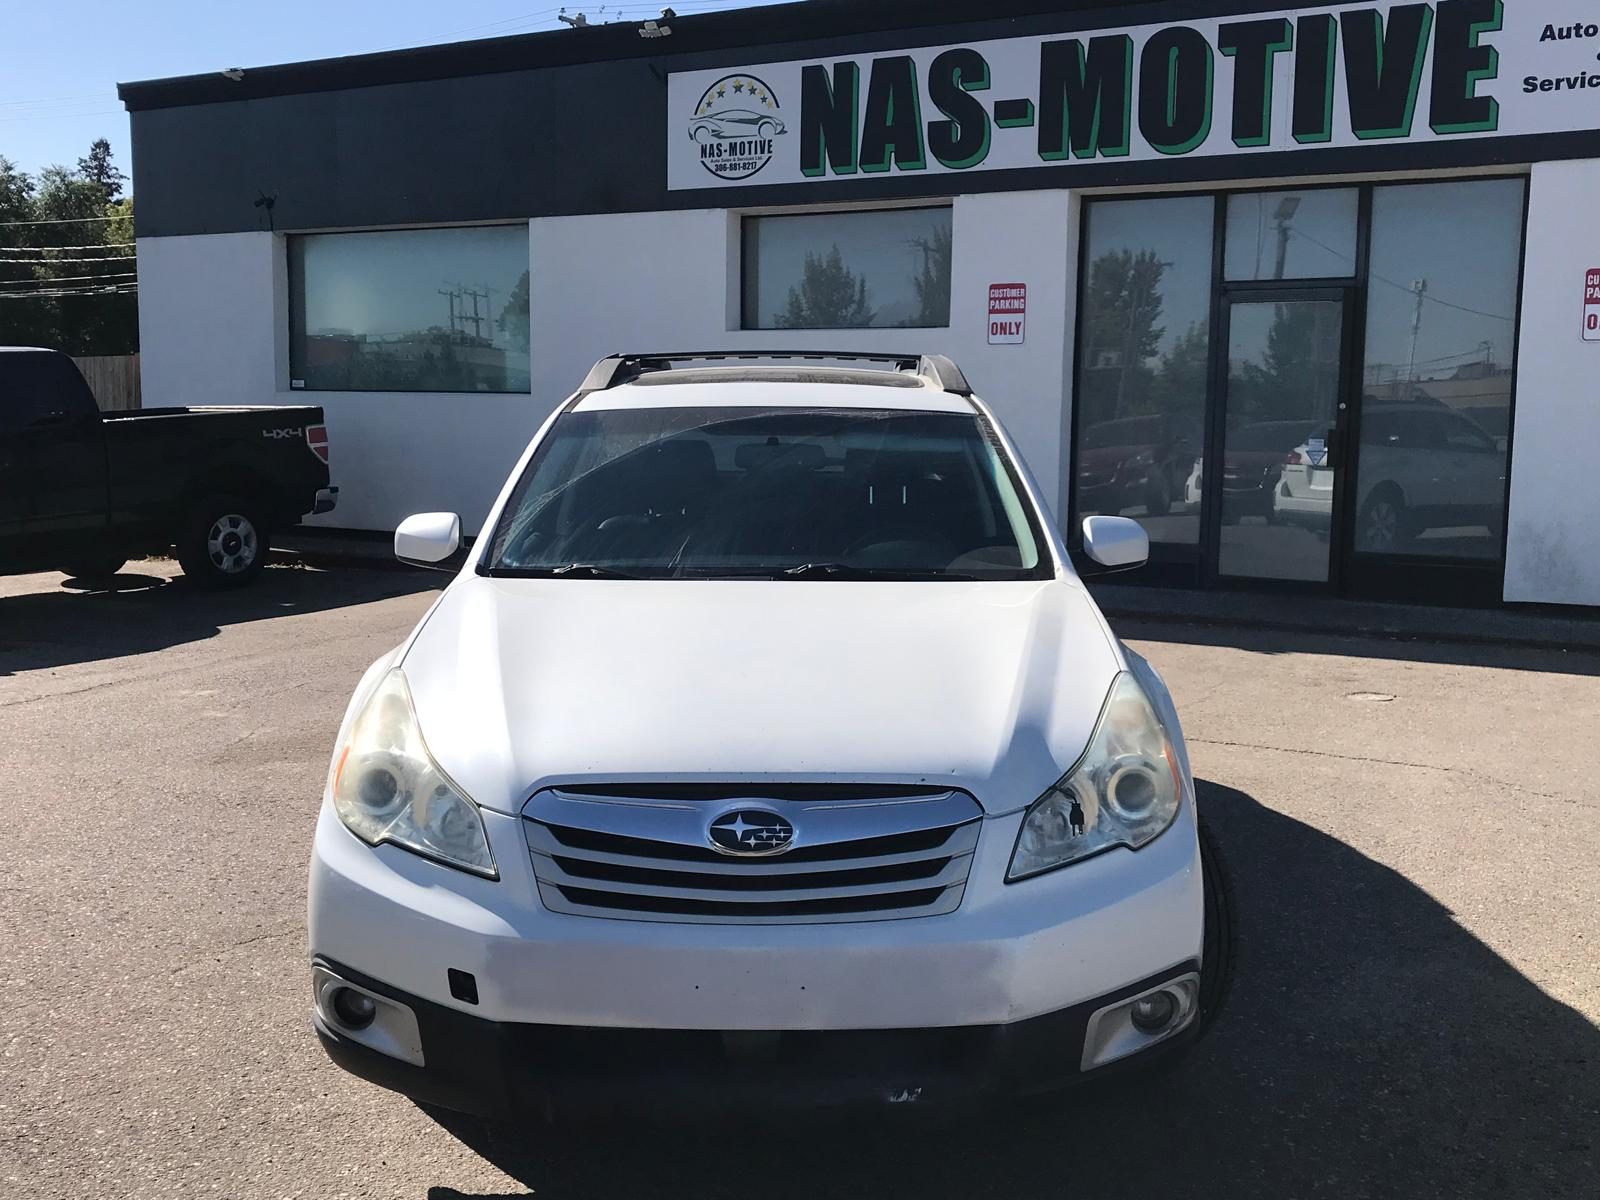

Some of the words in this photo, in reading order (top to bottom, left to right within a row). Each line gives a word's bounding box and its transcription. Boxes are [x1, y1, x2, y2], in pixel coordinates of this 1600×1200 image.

[1539, 23, 1599, 42] Auto
[801, 0, 1504, 177] NAS-MOTIVE
[1522, 71, 1600, 93] Servic
[701, 139, 773, 158] NAS-MOTIVE
[990, 288, 1025, 298] CUSTOMER
[990, 299, 1024, 310] PARKING
[991, 321, 1022, 336] ONLY
